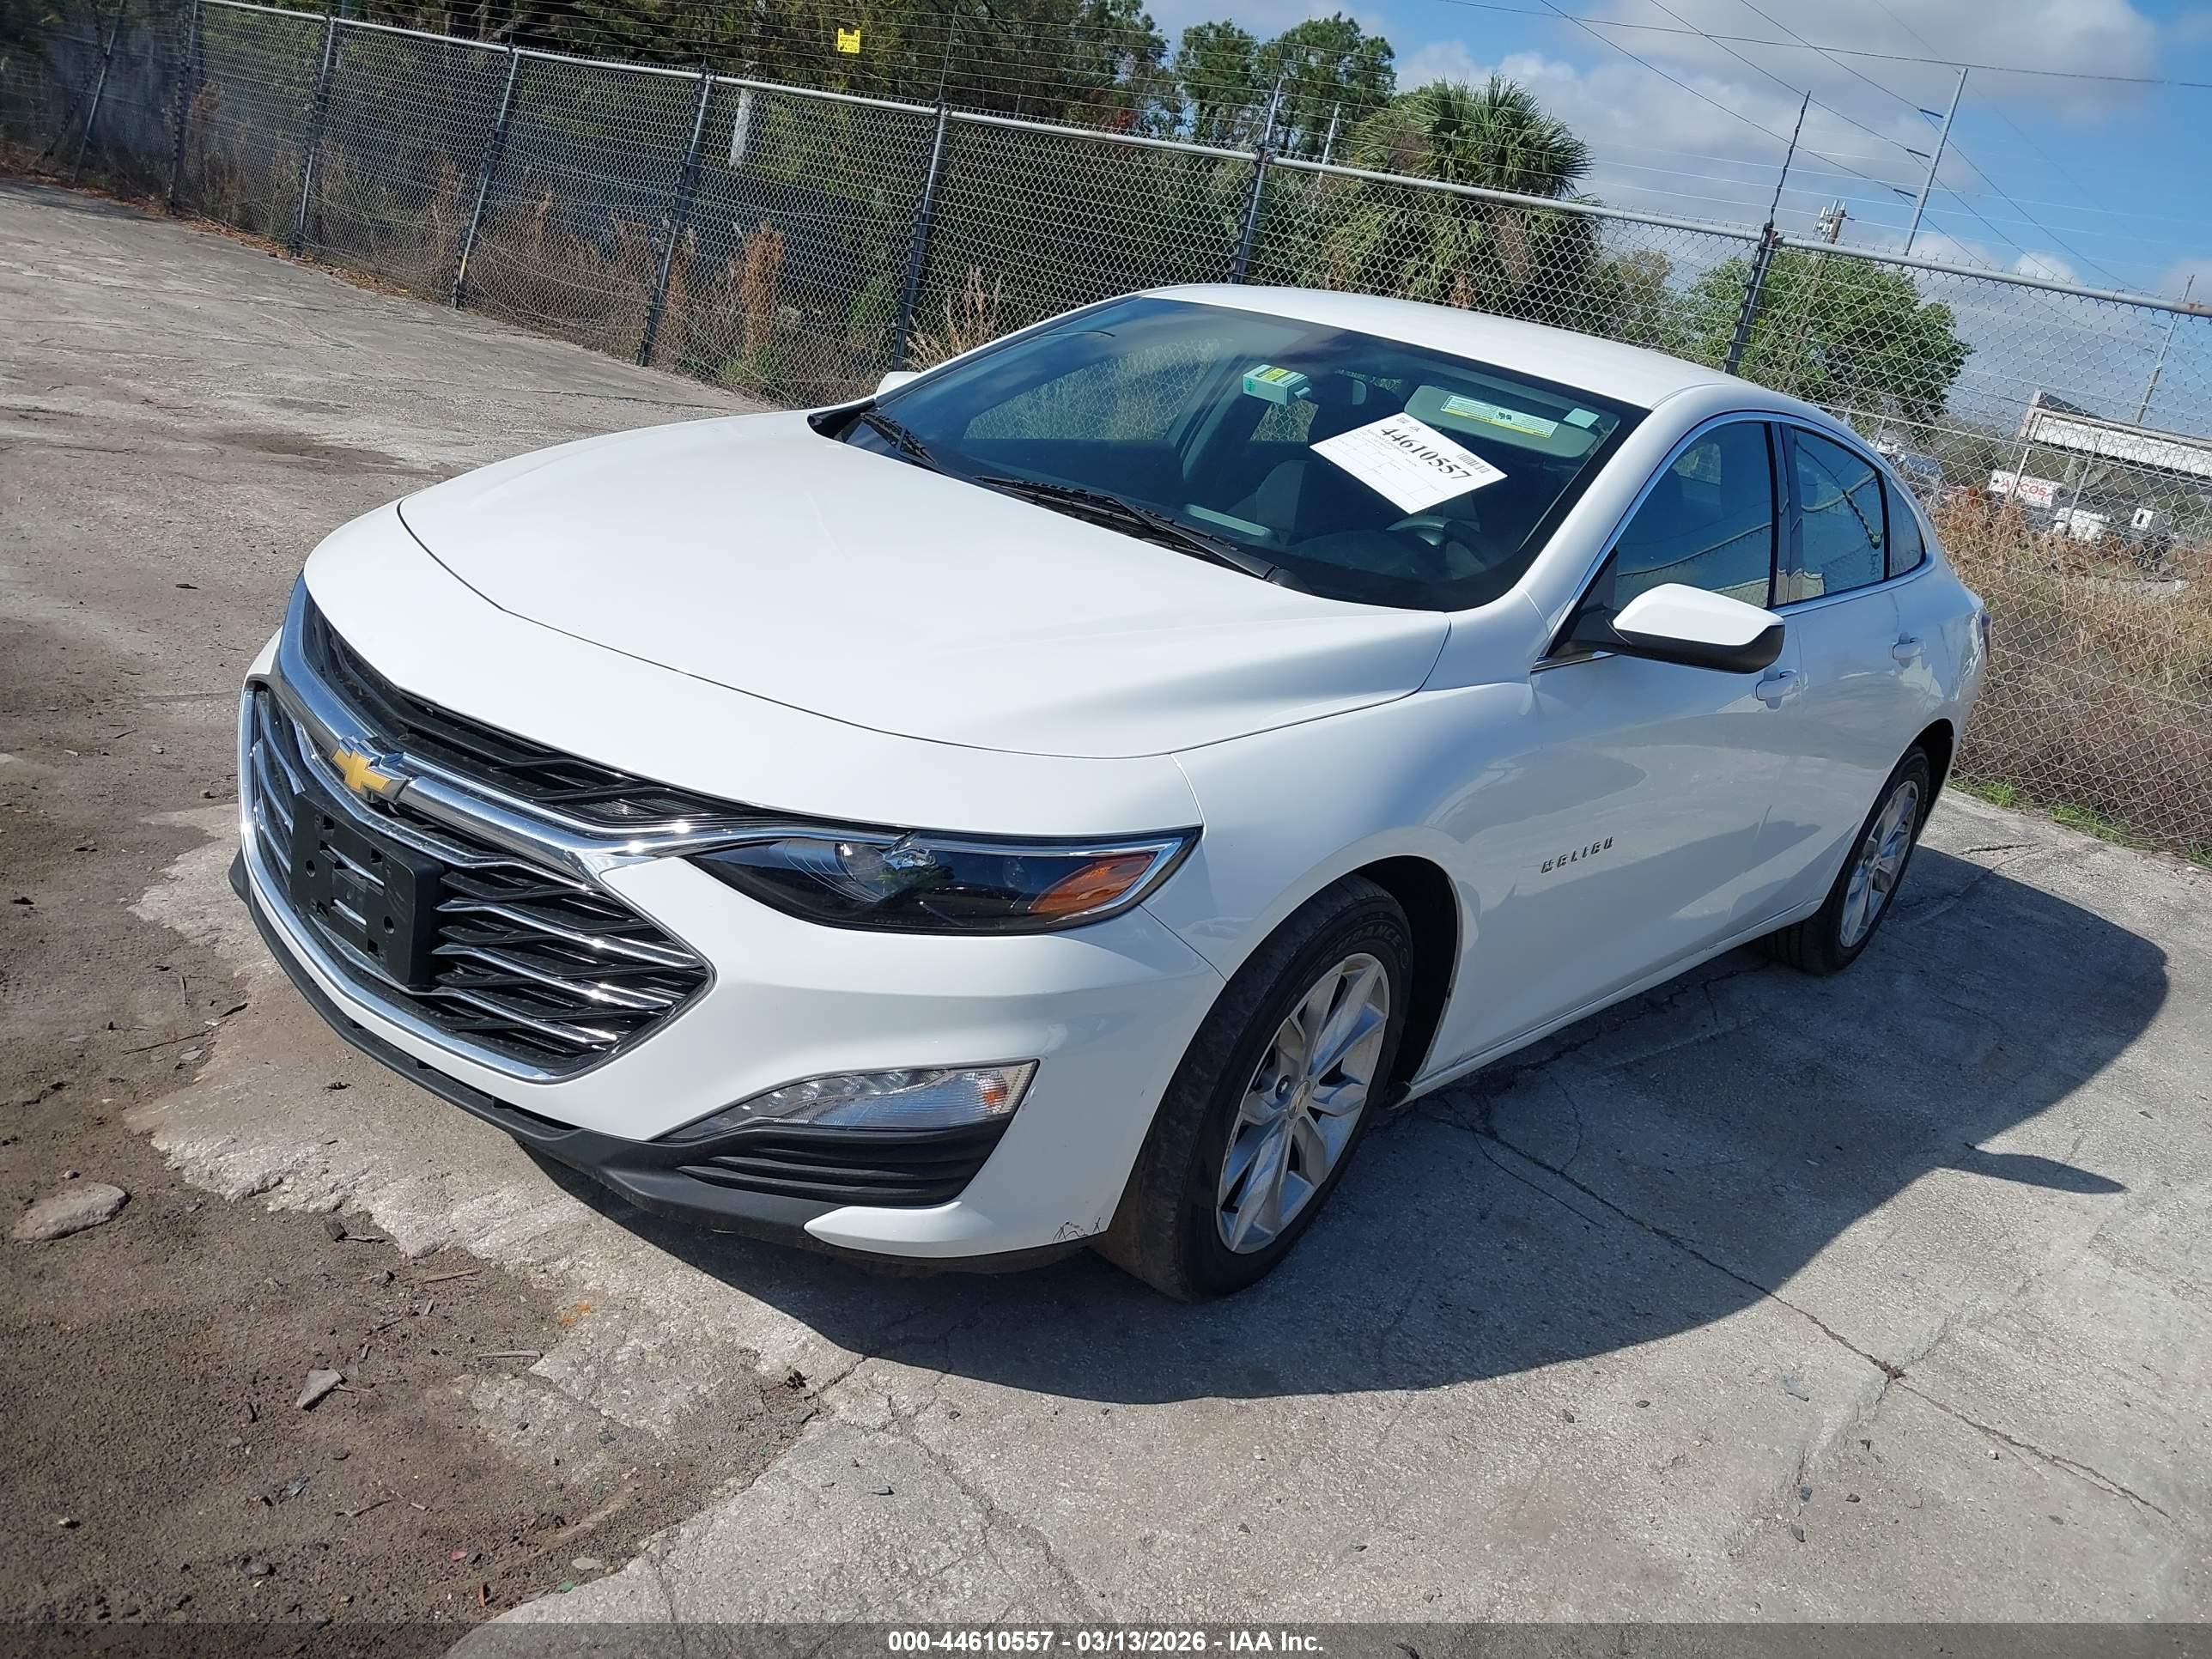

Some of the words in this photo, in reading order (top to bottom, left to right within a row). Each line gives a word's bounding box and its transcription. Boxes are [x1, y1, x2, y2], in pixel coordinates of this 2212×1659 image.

[1381, 428, 1472, 479] 44610557
[2001, 480, 2048, 496] ACOS
[1540, 836, 1614, 874] MALIBU
